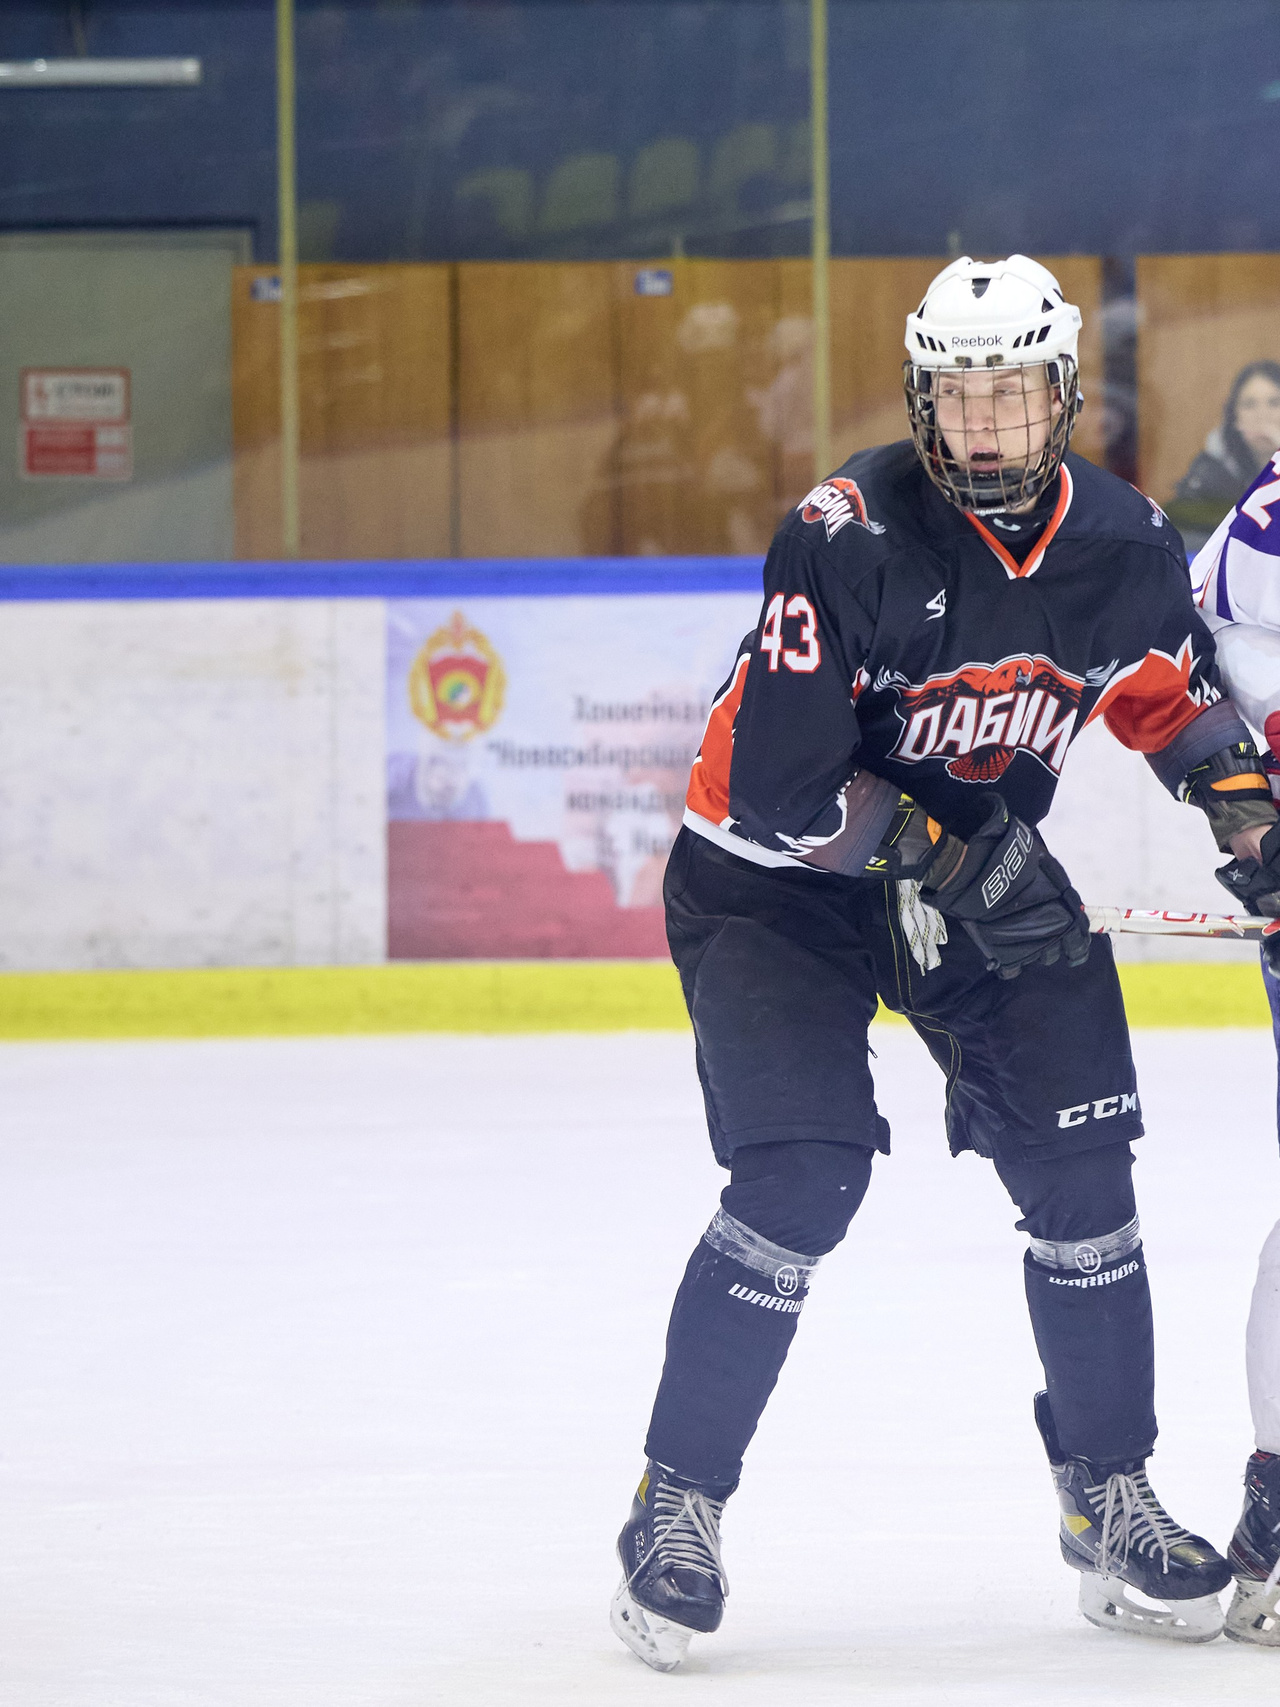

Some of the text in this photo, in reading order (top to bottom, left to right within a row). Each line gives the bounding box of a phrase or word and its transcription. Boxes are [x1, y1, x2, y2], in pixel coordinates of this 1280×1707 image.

[951, 335, 1003, 348] Reebok
[760, 592, 822, 673] 43
[1055, 1092, 1137, 1129] CCM
